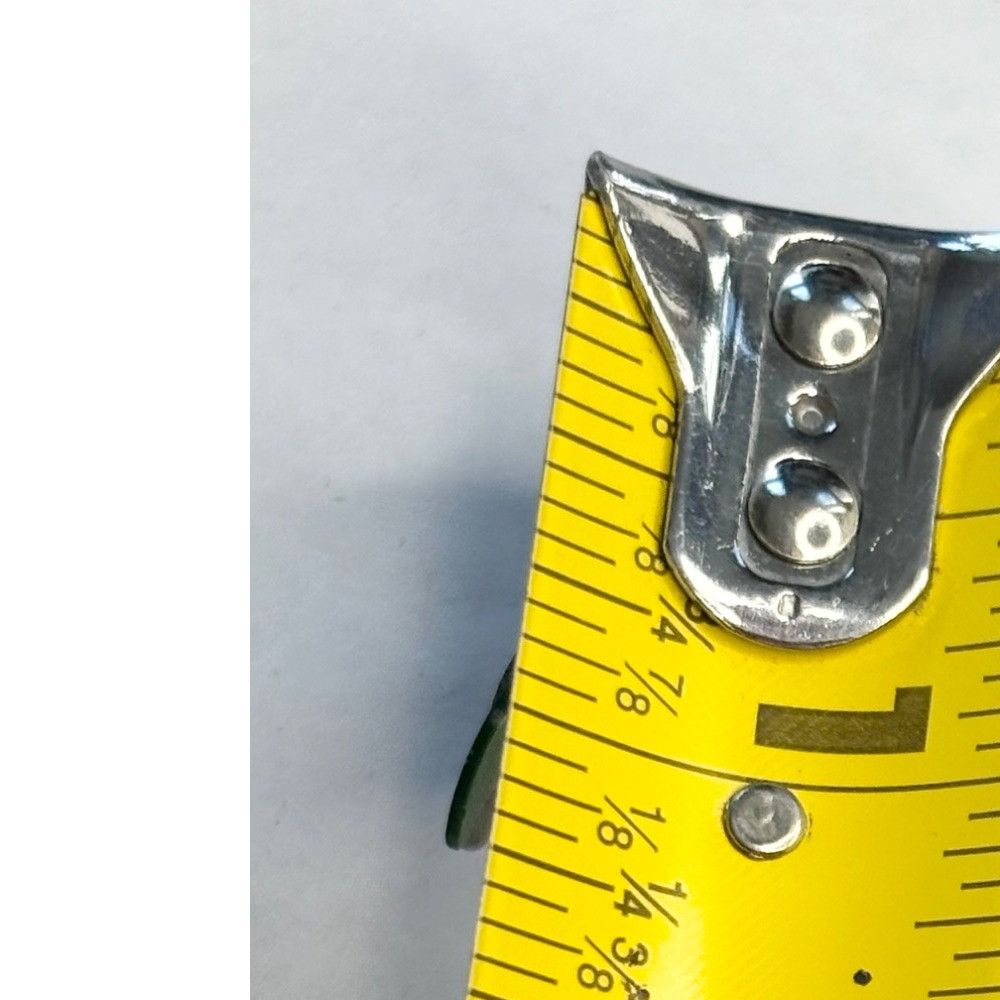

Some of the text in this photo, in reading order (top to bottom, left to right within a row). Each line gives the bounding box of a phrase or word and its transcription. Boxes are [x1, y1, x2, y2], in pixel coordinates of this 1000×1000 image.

[614, 661, 685, 716] 7/8
[754, 685, 932, 752] 1
[596, 796, 667, 853] 1/8
[614, 869, 687, 926] 1/4
[577, 935, 649, 994] 3/8
